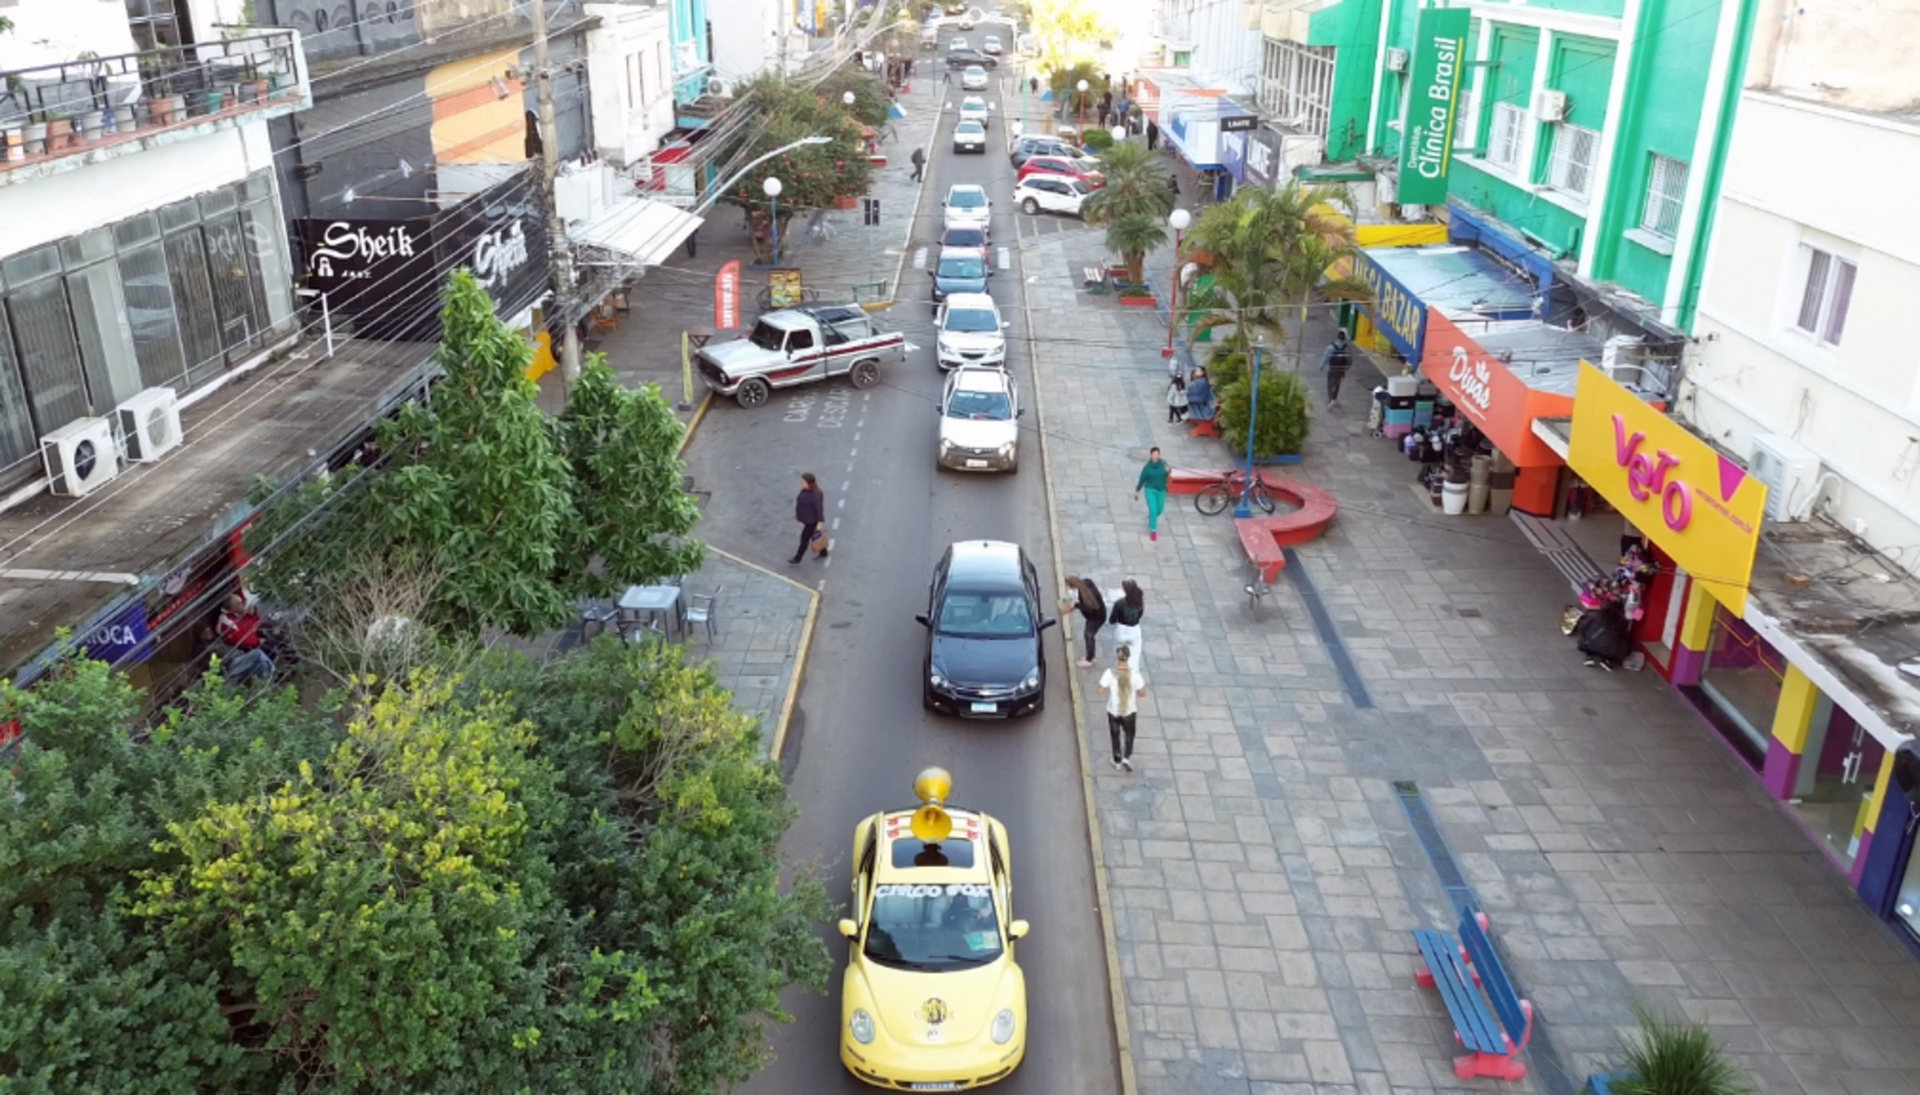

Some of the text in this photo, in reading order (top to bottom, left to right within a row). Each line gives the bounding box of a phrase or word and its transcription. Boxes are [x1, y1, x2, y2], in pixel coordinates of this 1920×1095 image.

[1418, 36, 1457, 178] Clínica Brasil
[310, 221, 415, 269] Sheik
[1381, 280, 1421, 349] BAZAR
